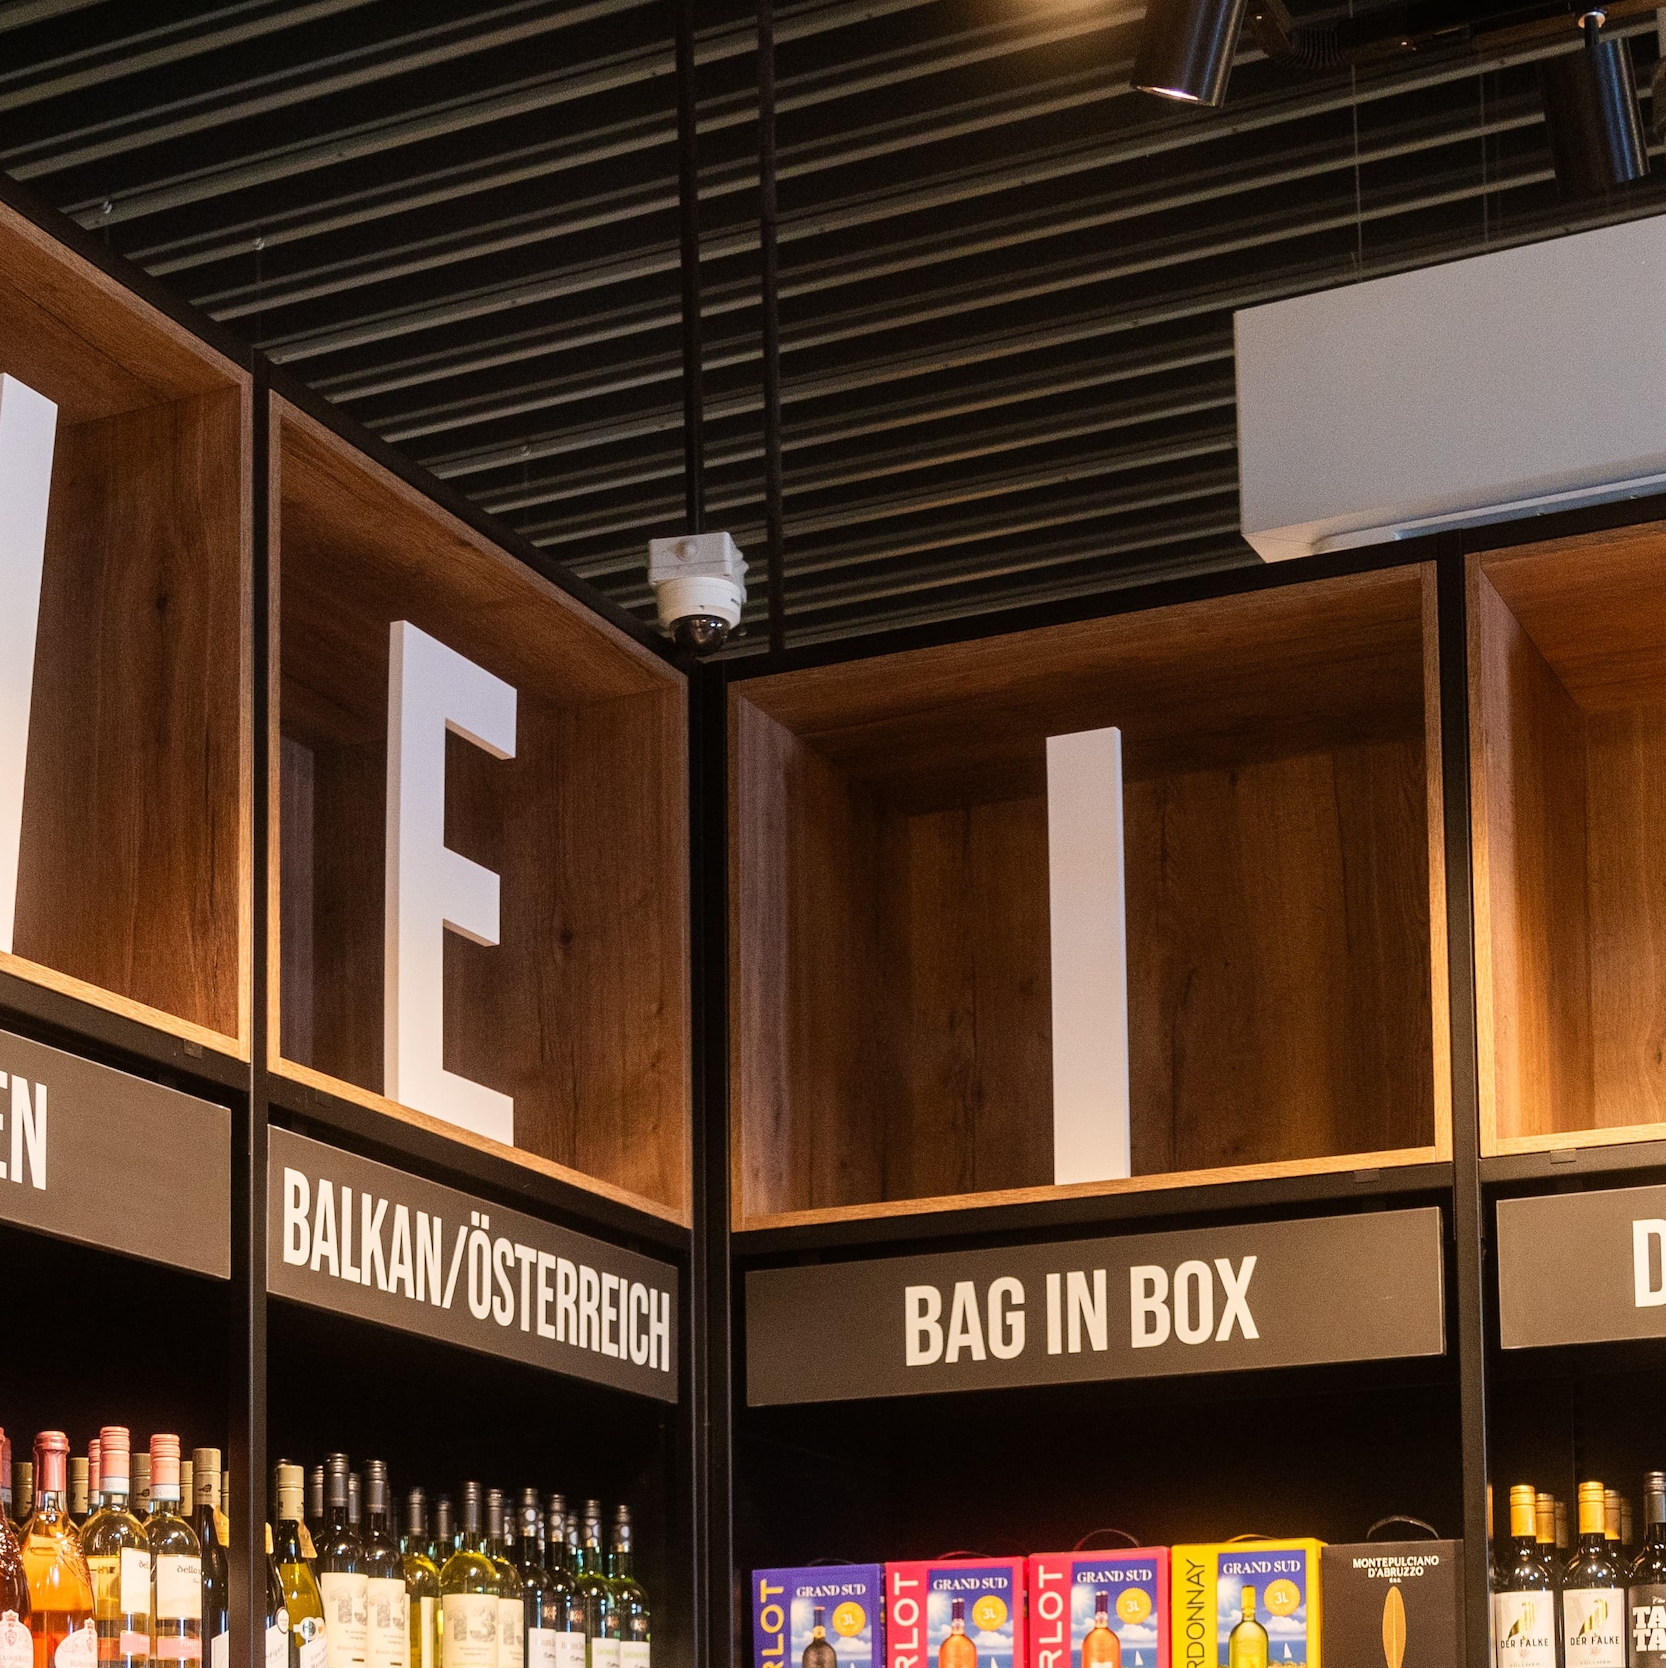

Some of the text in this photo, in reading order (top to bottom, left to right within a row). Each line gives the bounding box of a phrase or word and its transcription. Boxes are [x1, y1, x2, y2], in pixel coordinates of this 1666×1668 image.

[283, 1168, 670, 1373] BALKAN/ÖSTERREICH
[904, 1255, 1260, 1367] BAG IN BOX
[1223, 1560, 1301, 1575] GRAND SUD
[1353, 1555, 1439, 1569] MONTEPULCIANO
[1368, 1567, 1424, 1578] D'ABRUZZO
[796, 1583, 866, 1598] GRAND SUD
[1501, 1638, 1549, 1649] DER FALKE
